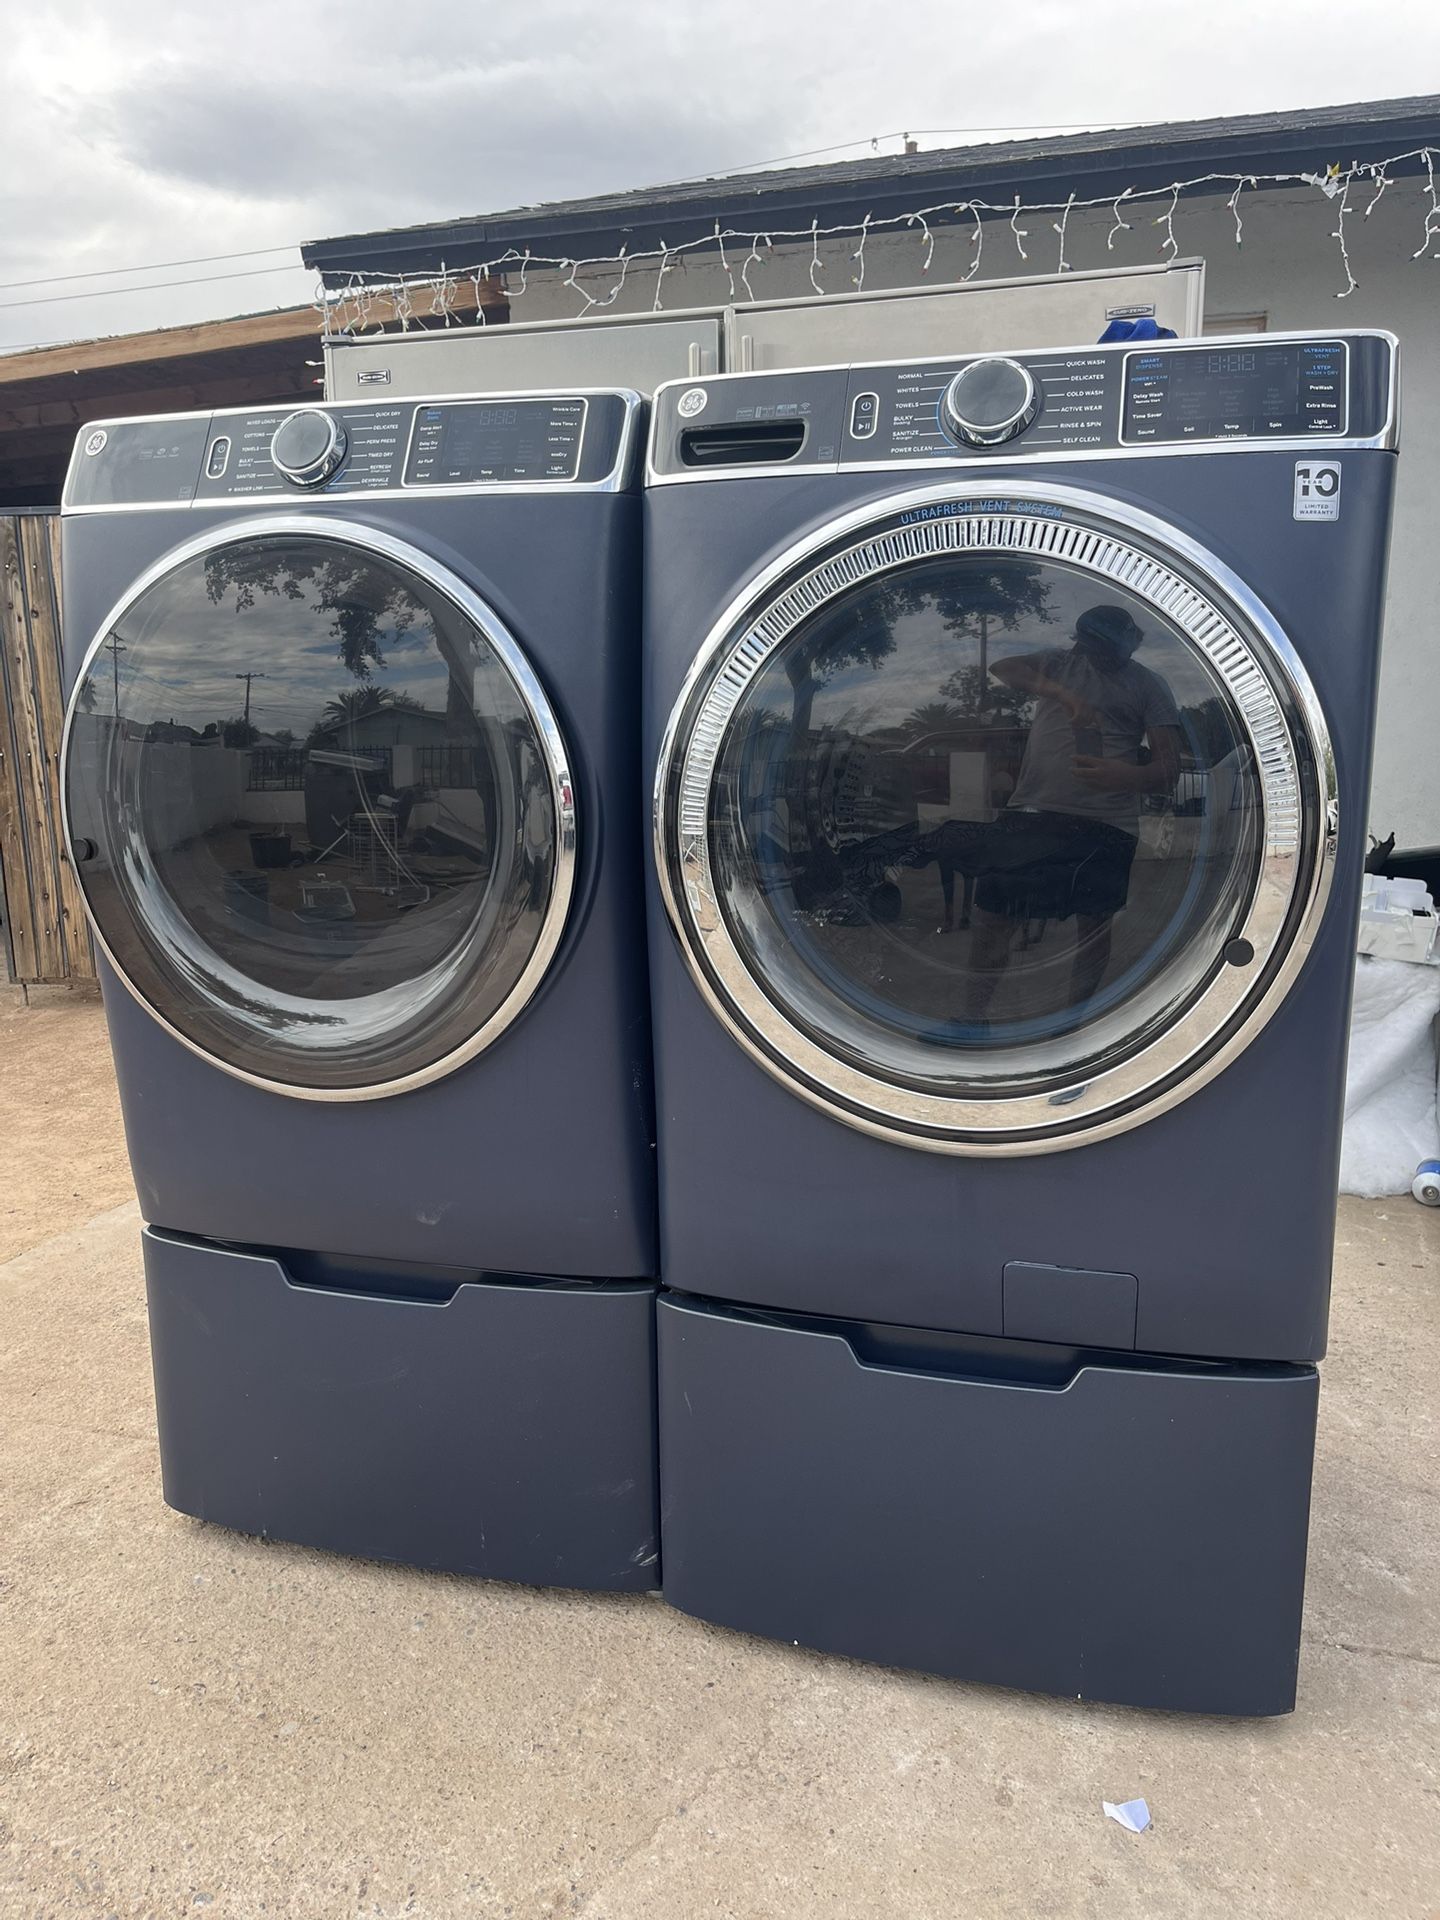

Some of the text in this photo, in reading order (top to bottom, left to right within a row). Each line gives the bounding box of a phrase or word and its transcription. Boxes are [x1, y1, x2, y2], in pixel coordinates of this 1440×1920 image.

[1297, 468, 1339, 497] 10
[901, 501, 1064, 524] ULTRAFRESH VENT SYSTEM
